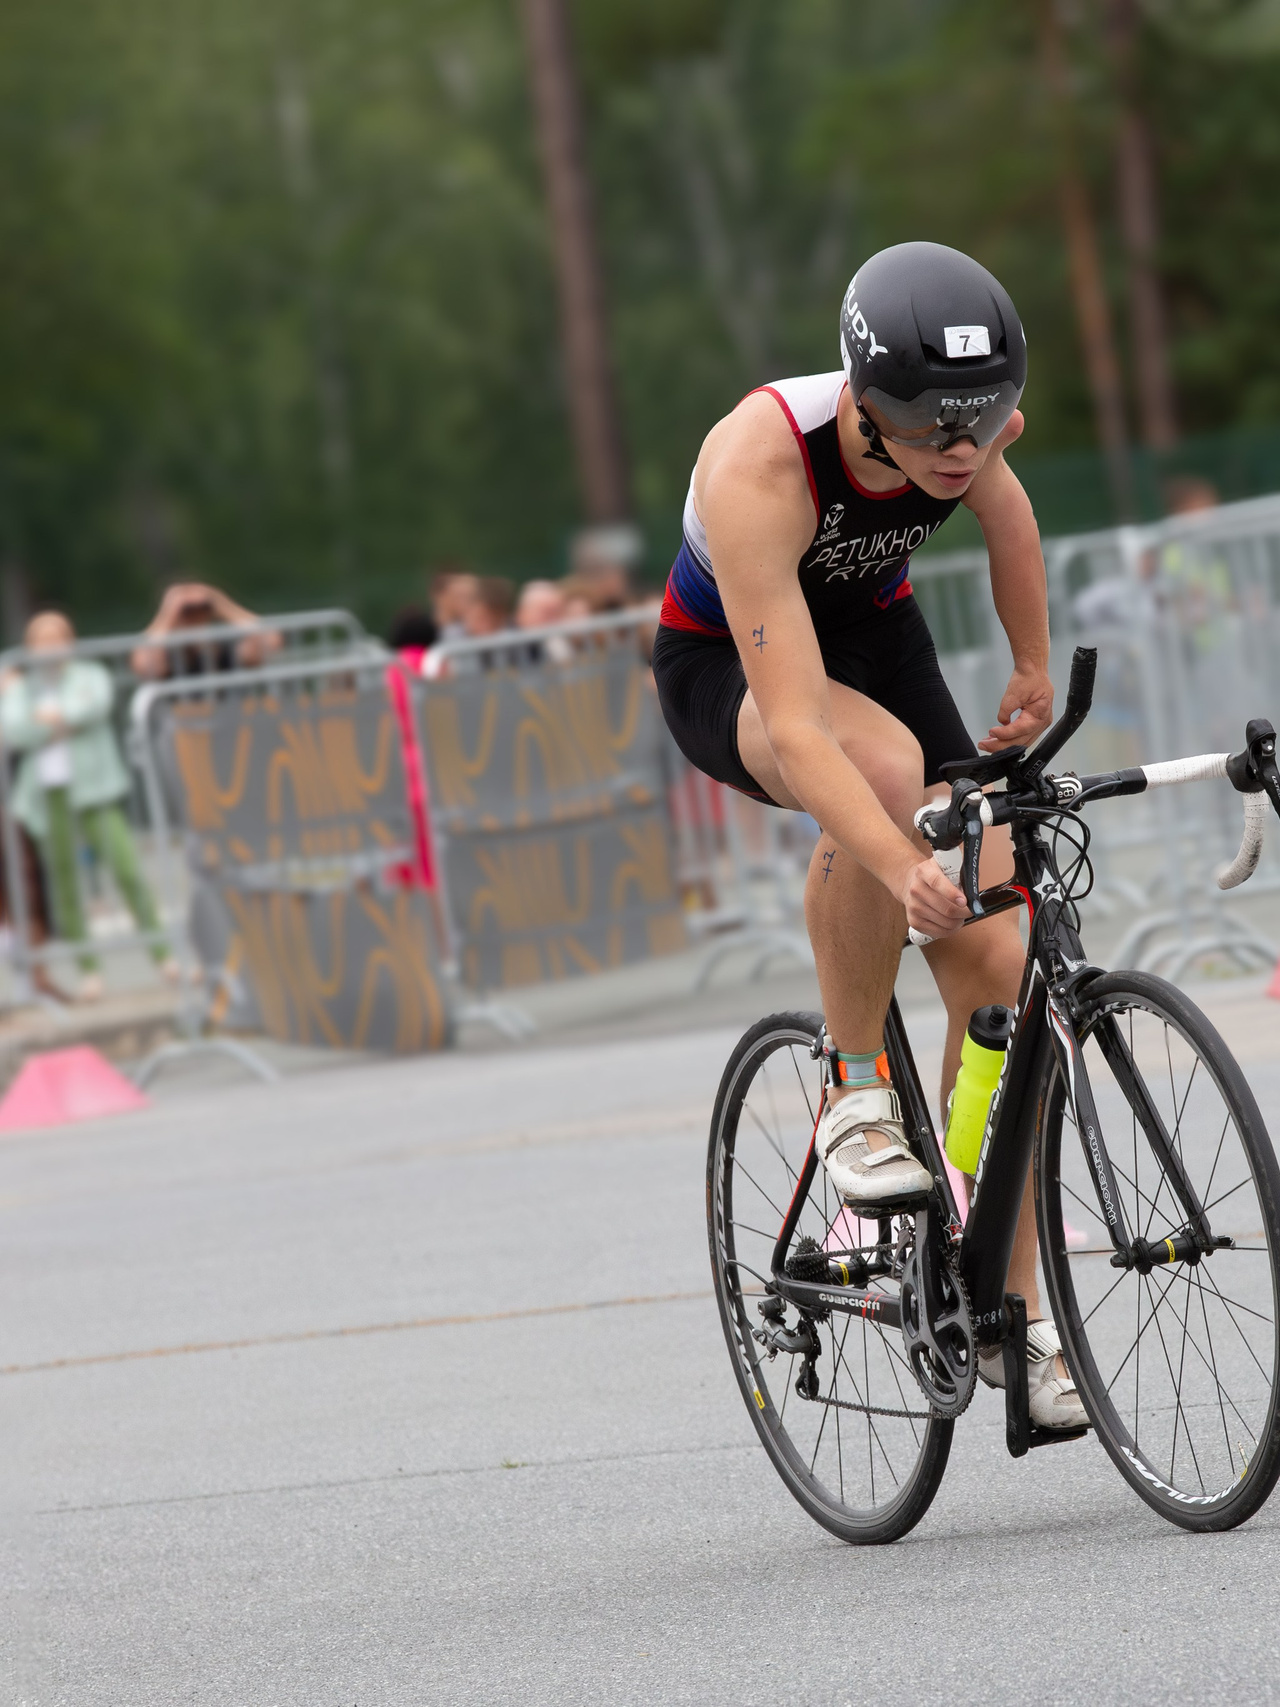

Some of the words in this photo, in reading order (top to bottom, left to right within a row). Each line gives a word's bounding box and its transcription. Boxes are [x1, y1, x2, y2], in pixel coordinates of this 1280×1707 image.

[959, 335, 970, 352] 7
[941, 392, 1000, 407] RUDY
[807, 520, 941, 568] PETUKHOV
[752, 624, 768, 654] 7
[822, 850, 836, 883] 7
